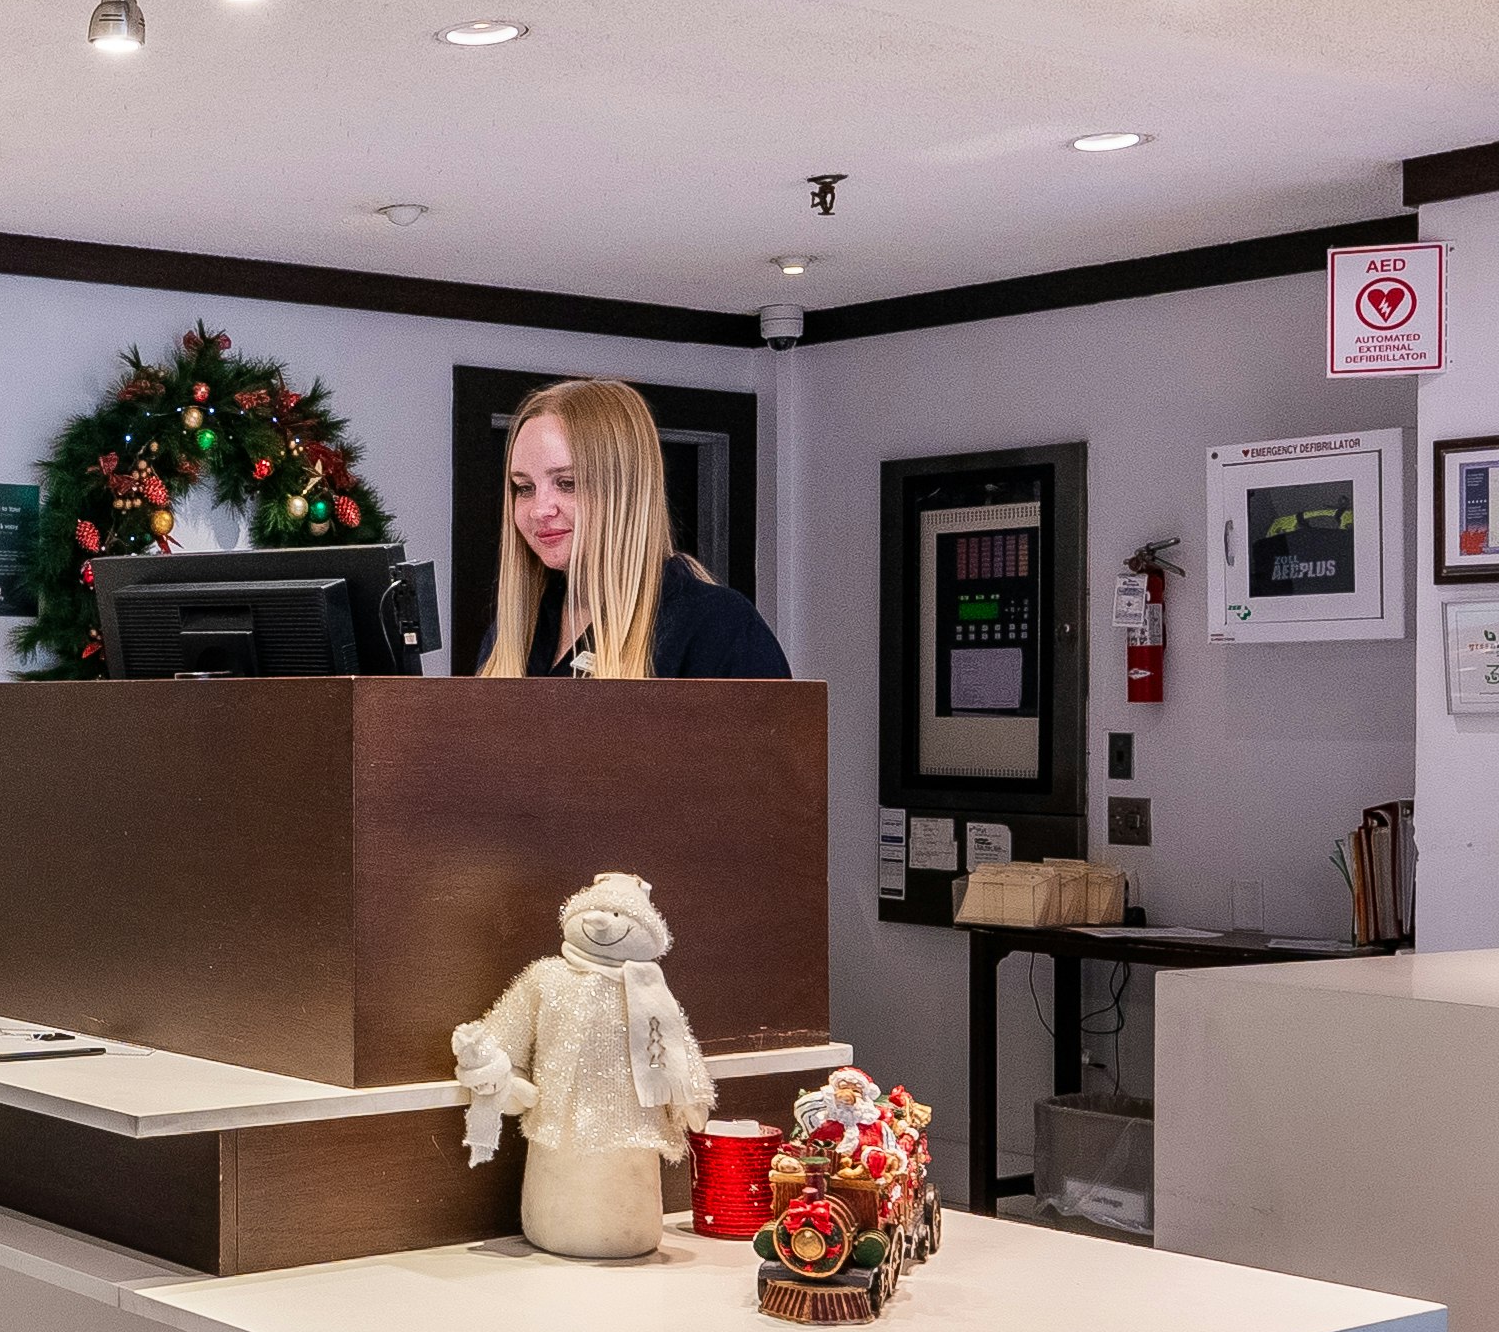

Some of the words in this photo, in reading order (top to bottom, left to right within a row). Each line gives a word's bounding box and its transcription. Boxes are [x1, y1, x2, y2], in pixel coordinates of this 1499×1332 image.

[1366, 258, 1406, 274] AED
[1355, 333, 1421, 344] AUTOMATED
[1358, 344, 1414, 354] EXTERNAL
[1344, 353, 1427, 364] DEFIBRILLATOR
[1250, 444, 1298, 458] EMERGENCY
[1299, 438, 1361, 454] DEFIBRILLATOR
